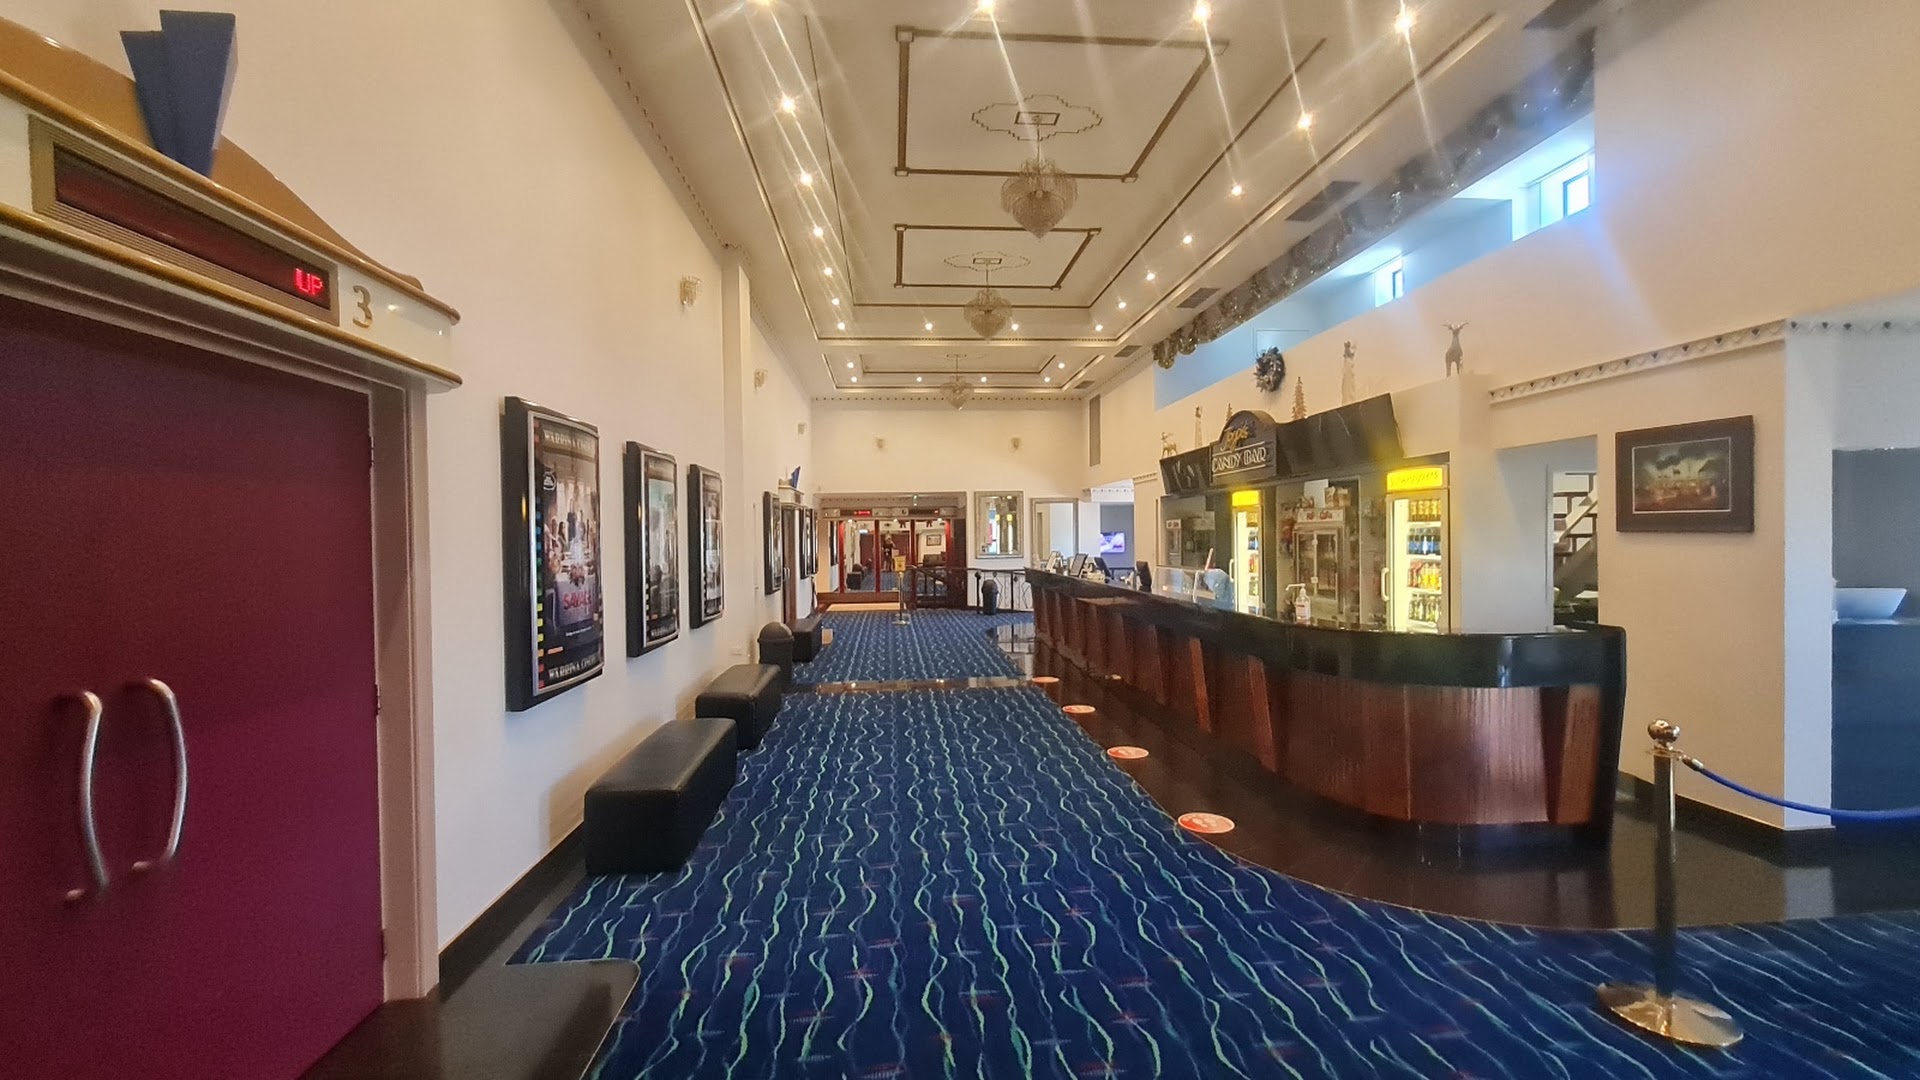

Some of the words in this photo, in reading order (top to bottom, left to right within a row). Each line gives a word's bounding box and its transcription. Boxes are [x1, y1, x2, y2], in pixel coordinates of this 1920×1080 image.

[295, 267, 324, 296] UP
[352, 285, 373, 329] 3
[1211, 452, 1242, 473] CANDY
[1243, 446, 1267, 465] BAR
